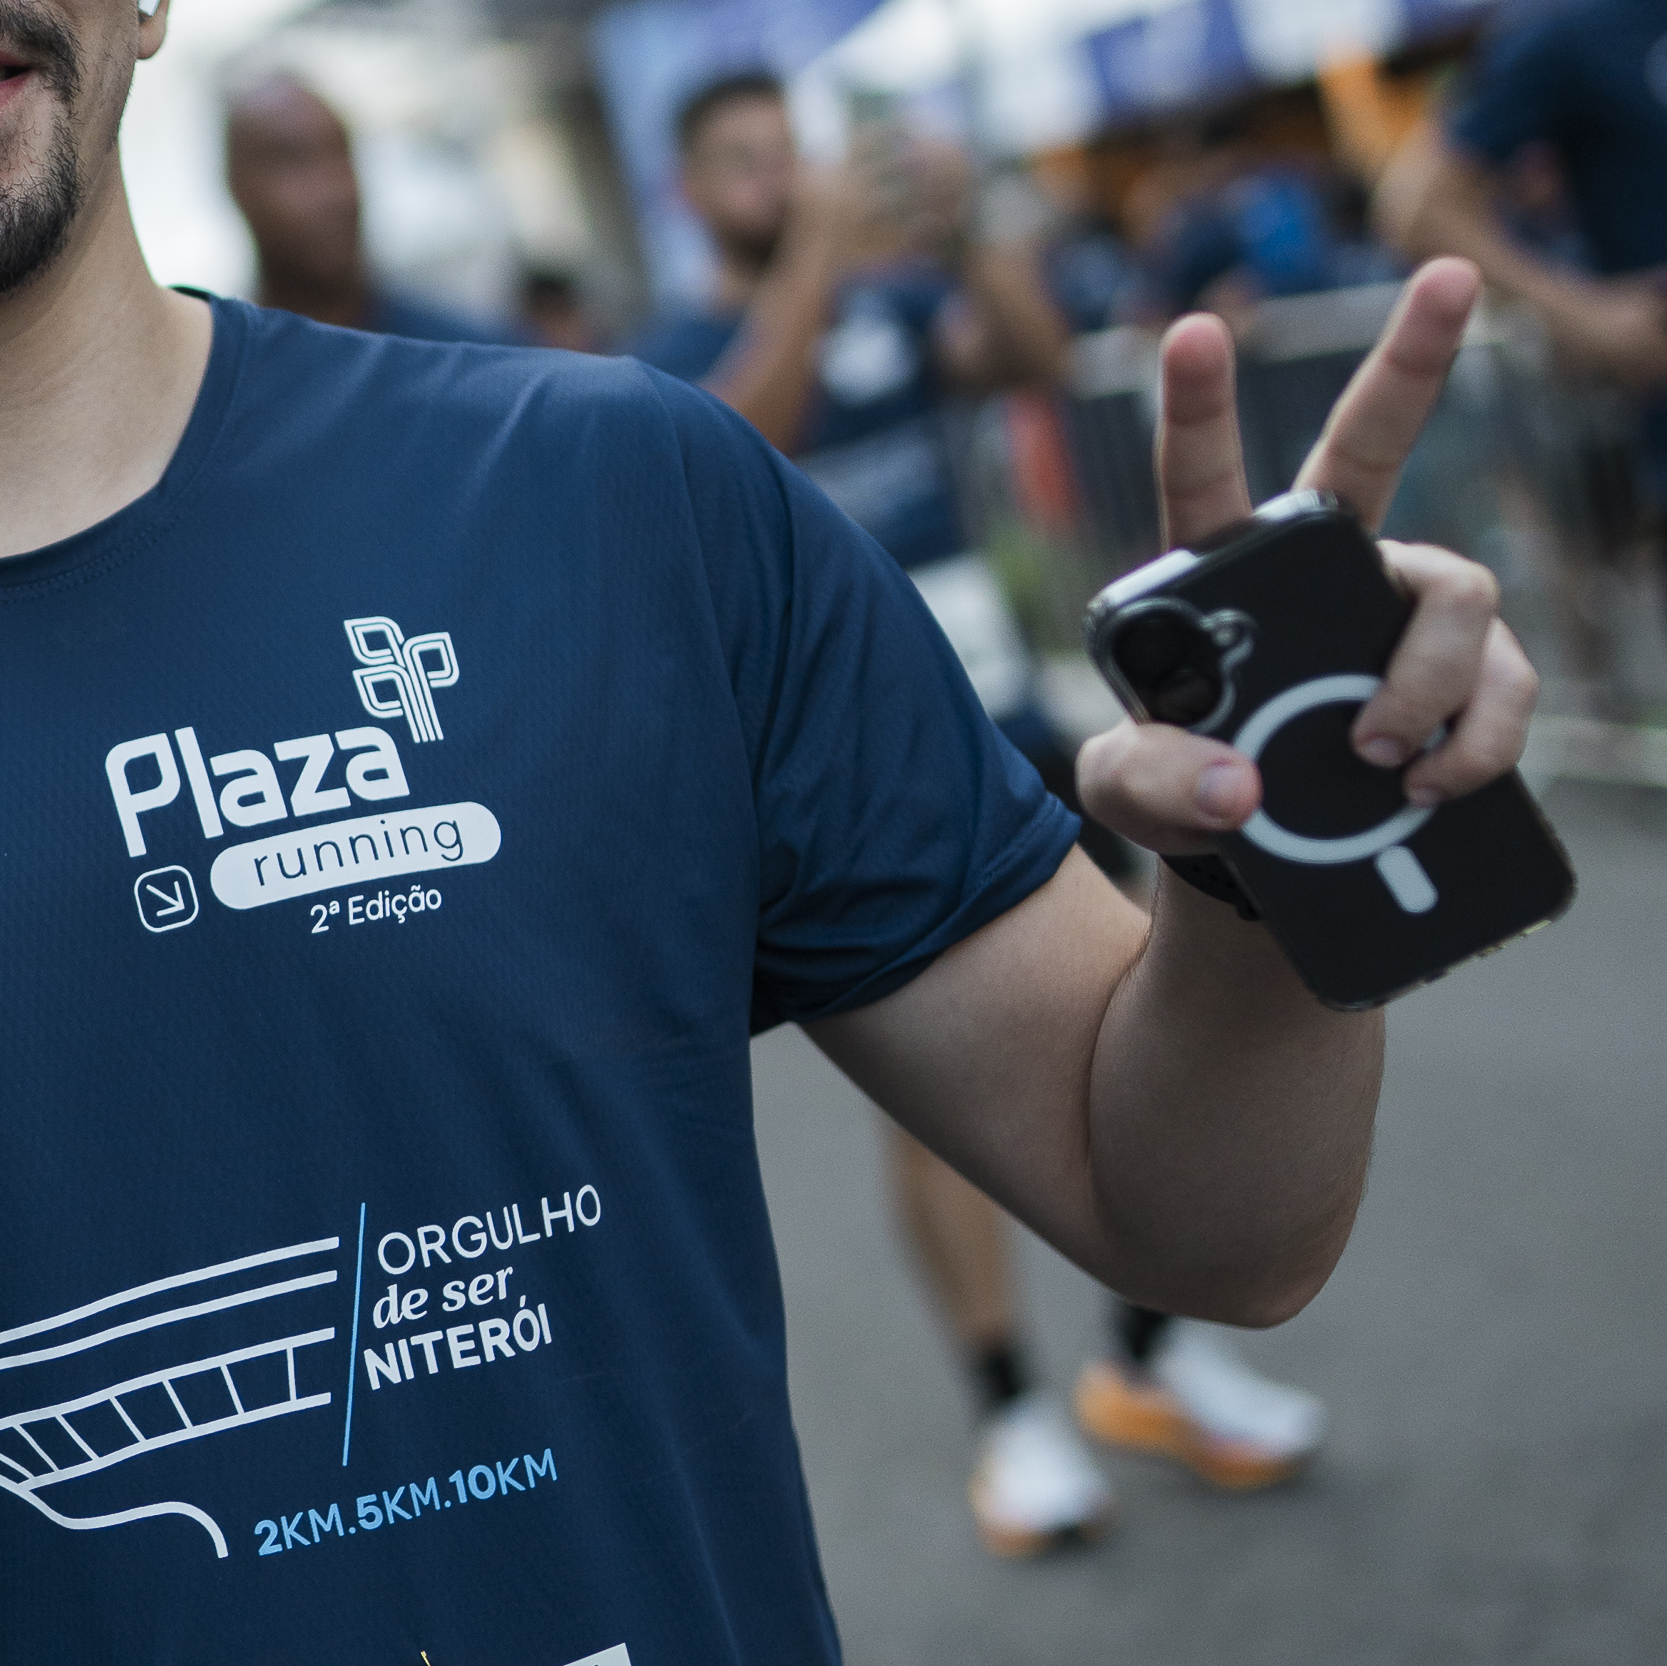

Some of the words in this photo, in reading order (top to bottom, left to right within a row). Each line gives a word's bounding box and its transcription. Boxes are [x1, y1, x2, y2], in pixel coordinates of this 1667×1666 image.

[104, 726, 410, 858] Plaza
[253, 818, 465, 887] running
[310, 898, 340, 933] 2ª
[348, 884, 442, 926] Edição
[377, 1184, 602, 1275] ORGULHO
[372, 1284, 429, 1329] de
[441, 1266, 514, 1313] ser
[363, 1294, 553, 1391] NITERÓI
